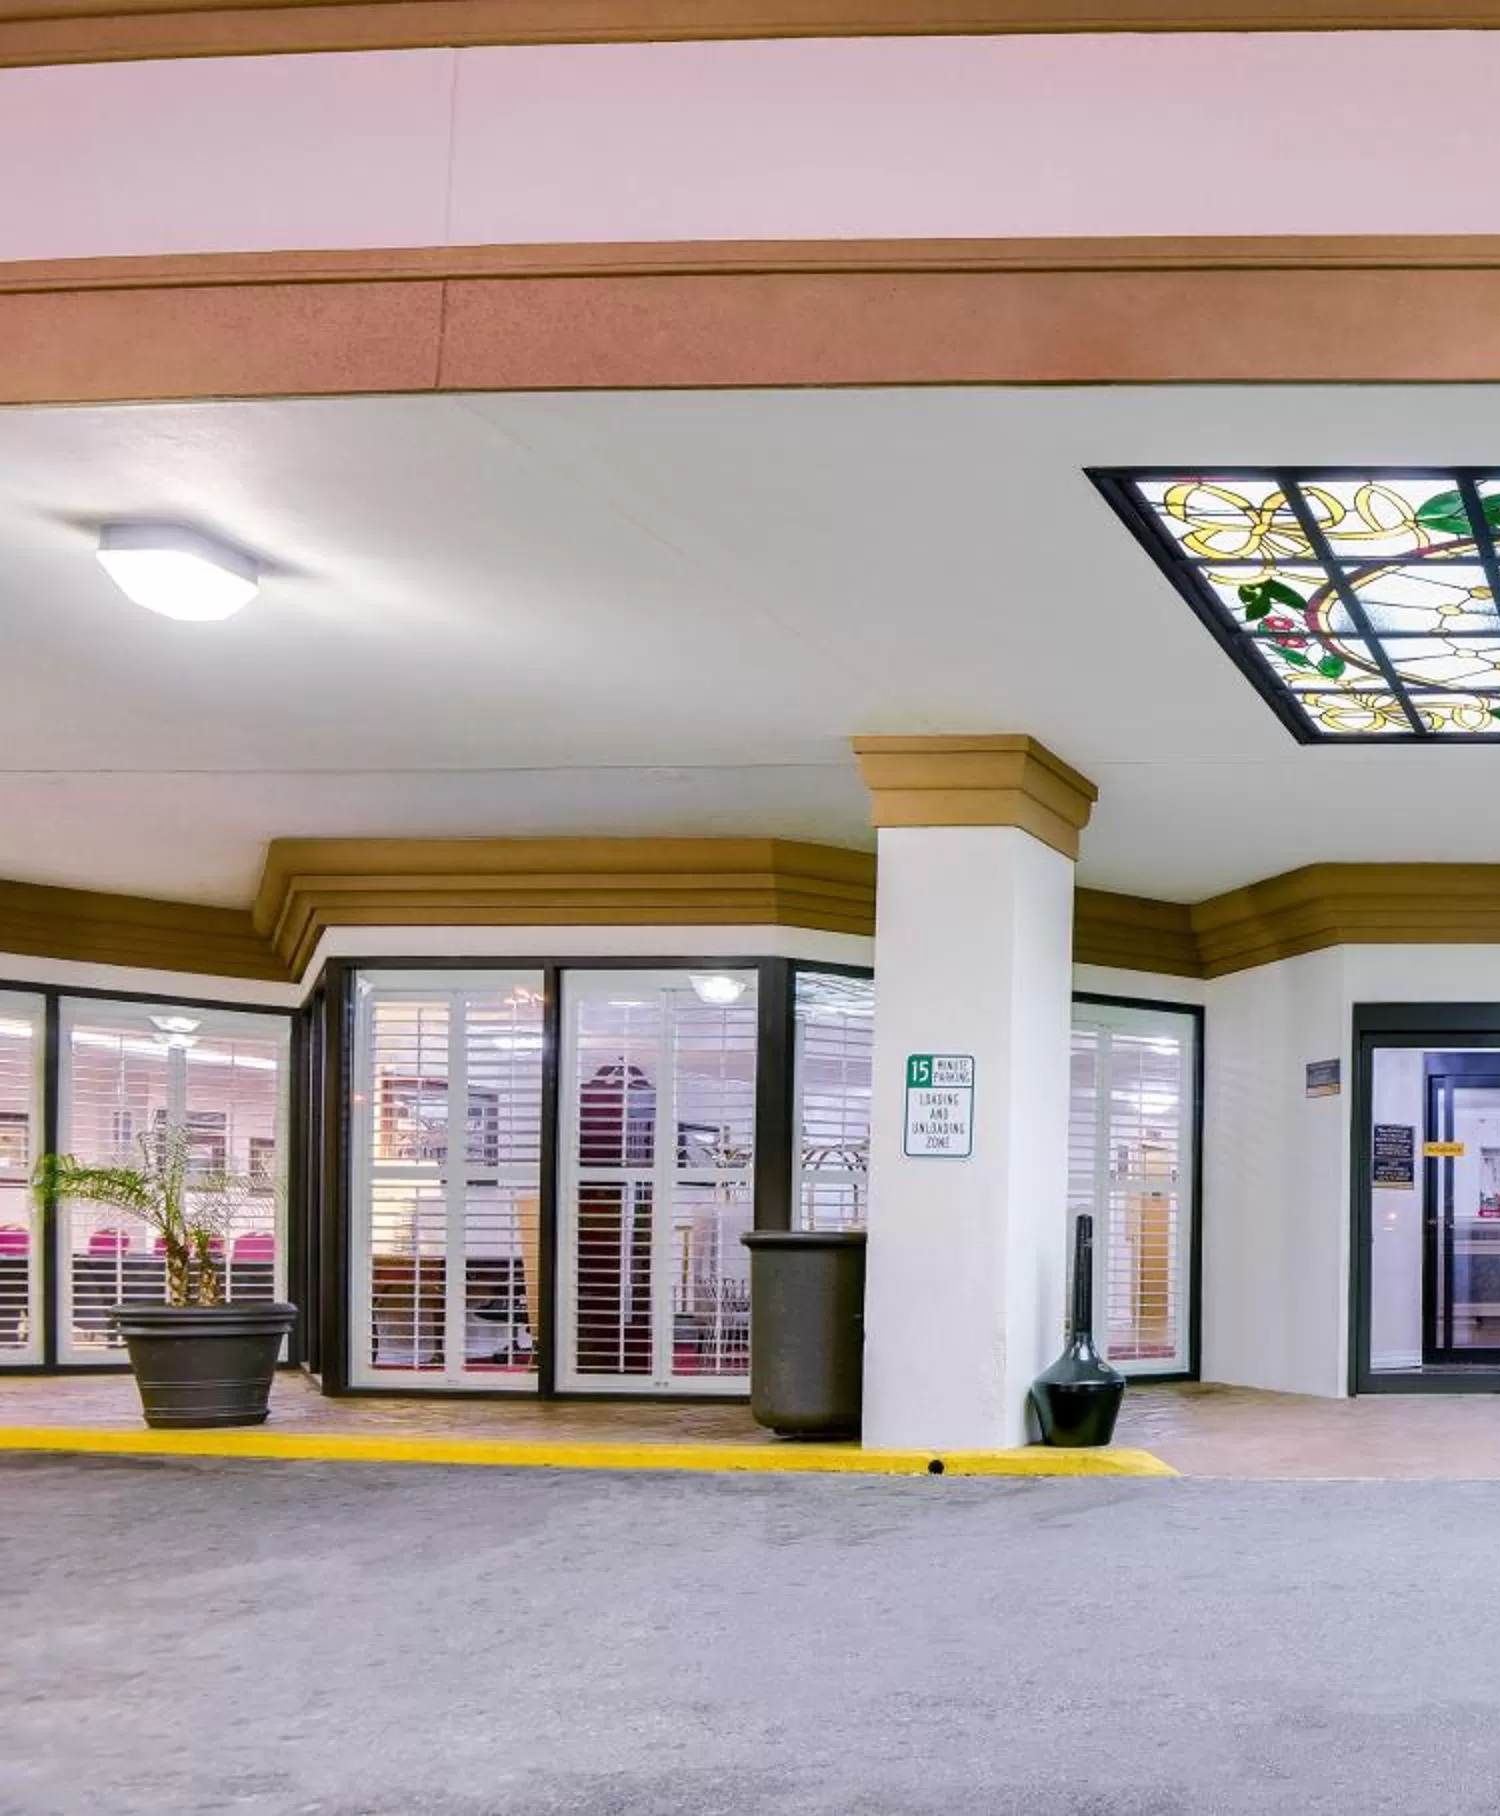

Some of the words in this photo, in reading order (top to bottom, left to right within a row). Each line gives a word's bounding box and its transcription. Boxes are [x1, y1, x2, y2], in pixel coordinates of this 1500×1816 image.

[911, 1061, 929, 1081] 15
[920, 1093, 959, 1106] LOADING
[930, 1108, 949, 1120] AND
[912, 1122, 965, 1134] UNLOADING
[926, 1136, 951, 1148] ZONE
